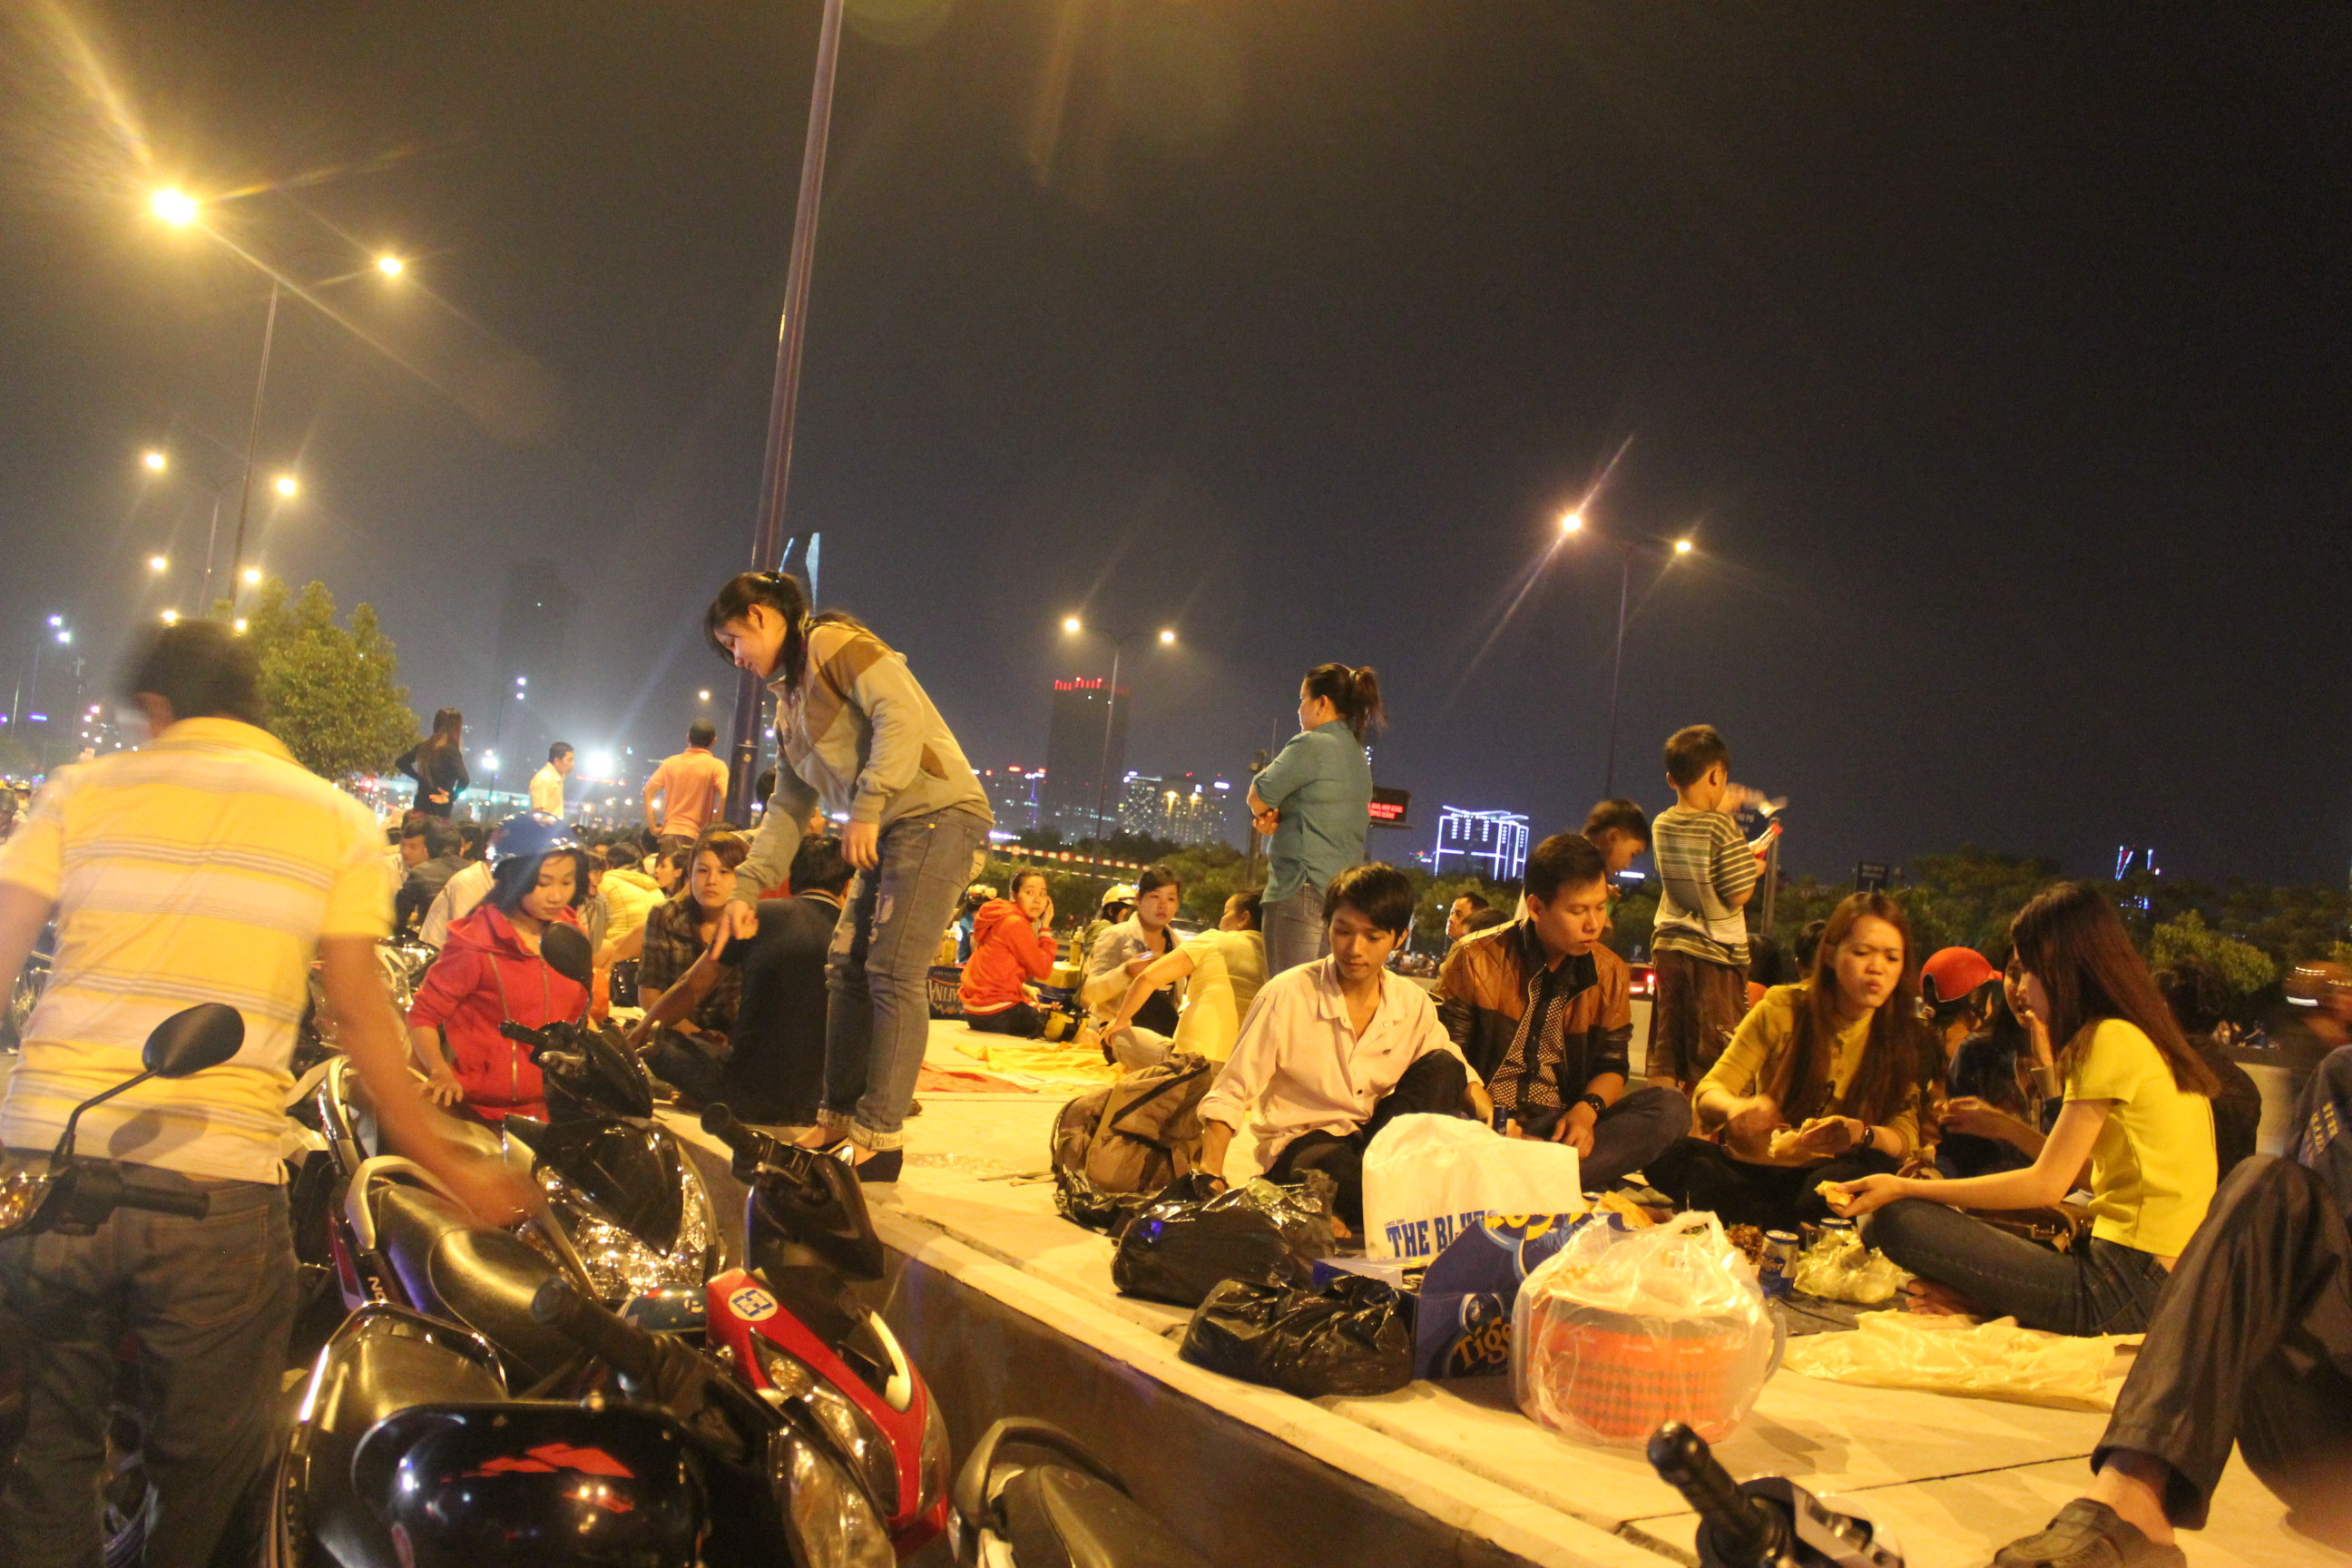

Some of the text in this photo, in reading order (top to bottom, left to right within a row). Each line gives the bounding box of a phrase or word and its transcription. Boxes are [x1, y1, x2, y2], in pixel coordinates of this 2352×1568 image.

[1386, 1220, 1430, 1259] THE
[1434, 1210, 1485, 1253] BL
[1452, 1316, 1513, 1369] Tige
